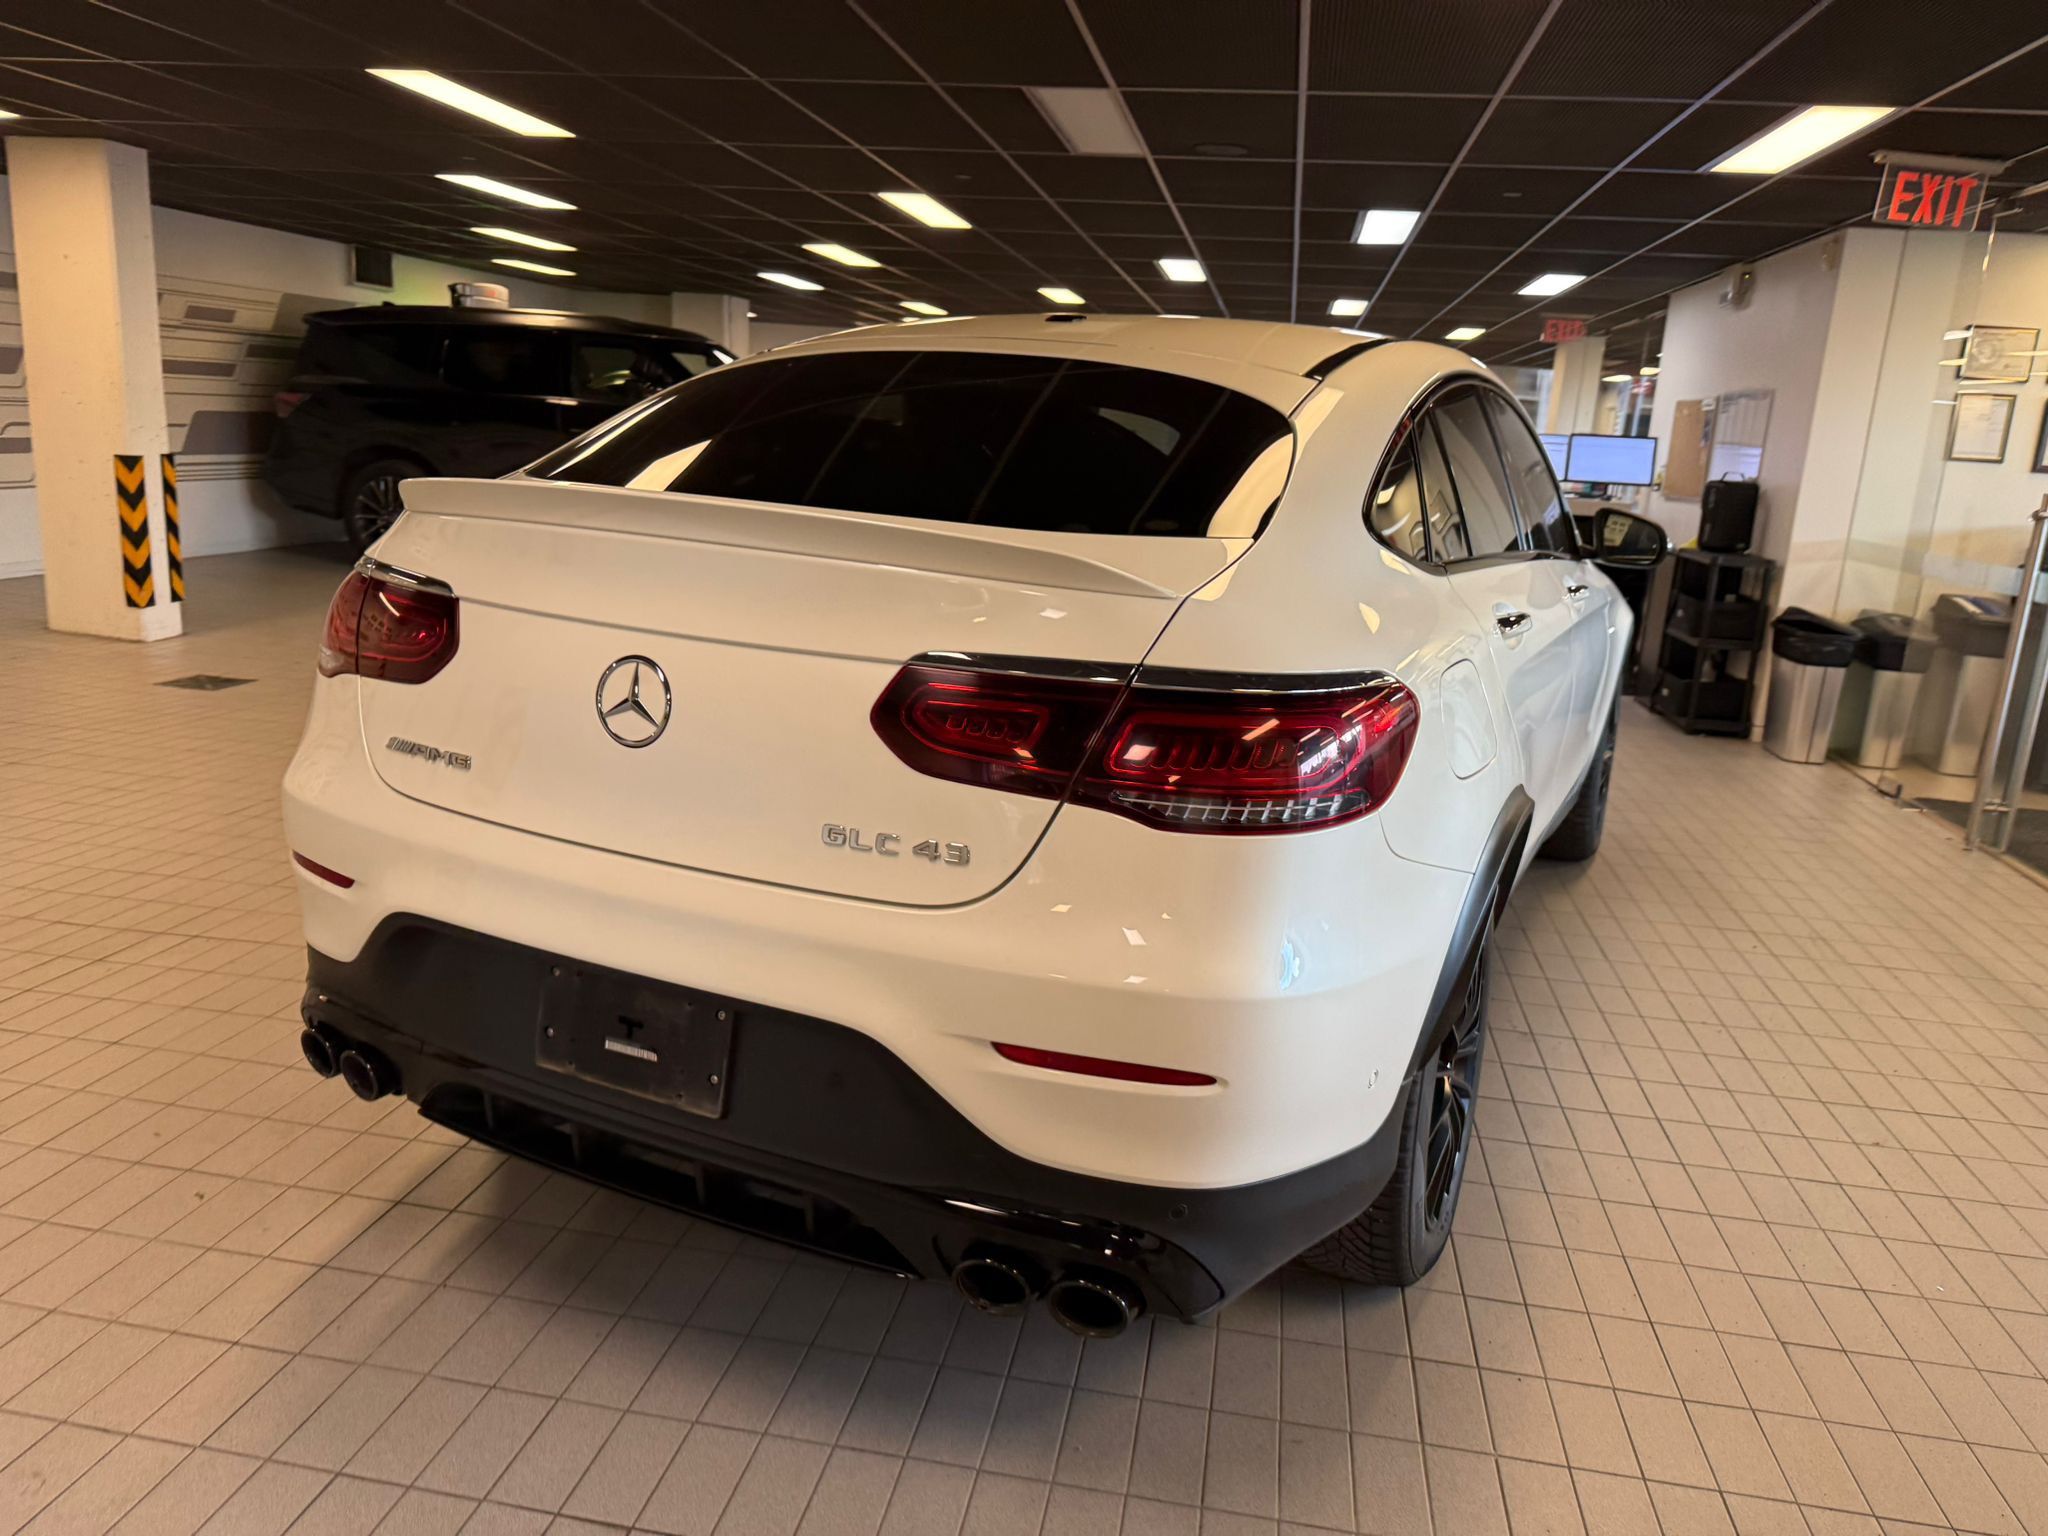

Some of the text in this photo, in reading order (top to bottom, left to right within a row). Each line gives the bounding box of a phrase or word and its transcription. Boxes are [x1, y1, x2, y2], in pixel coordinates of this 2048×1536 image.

[1887, 171, 1980, 228] EXIT
[821, 823, 971, 866] GLC 43
